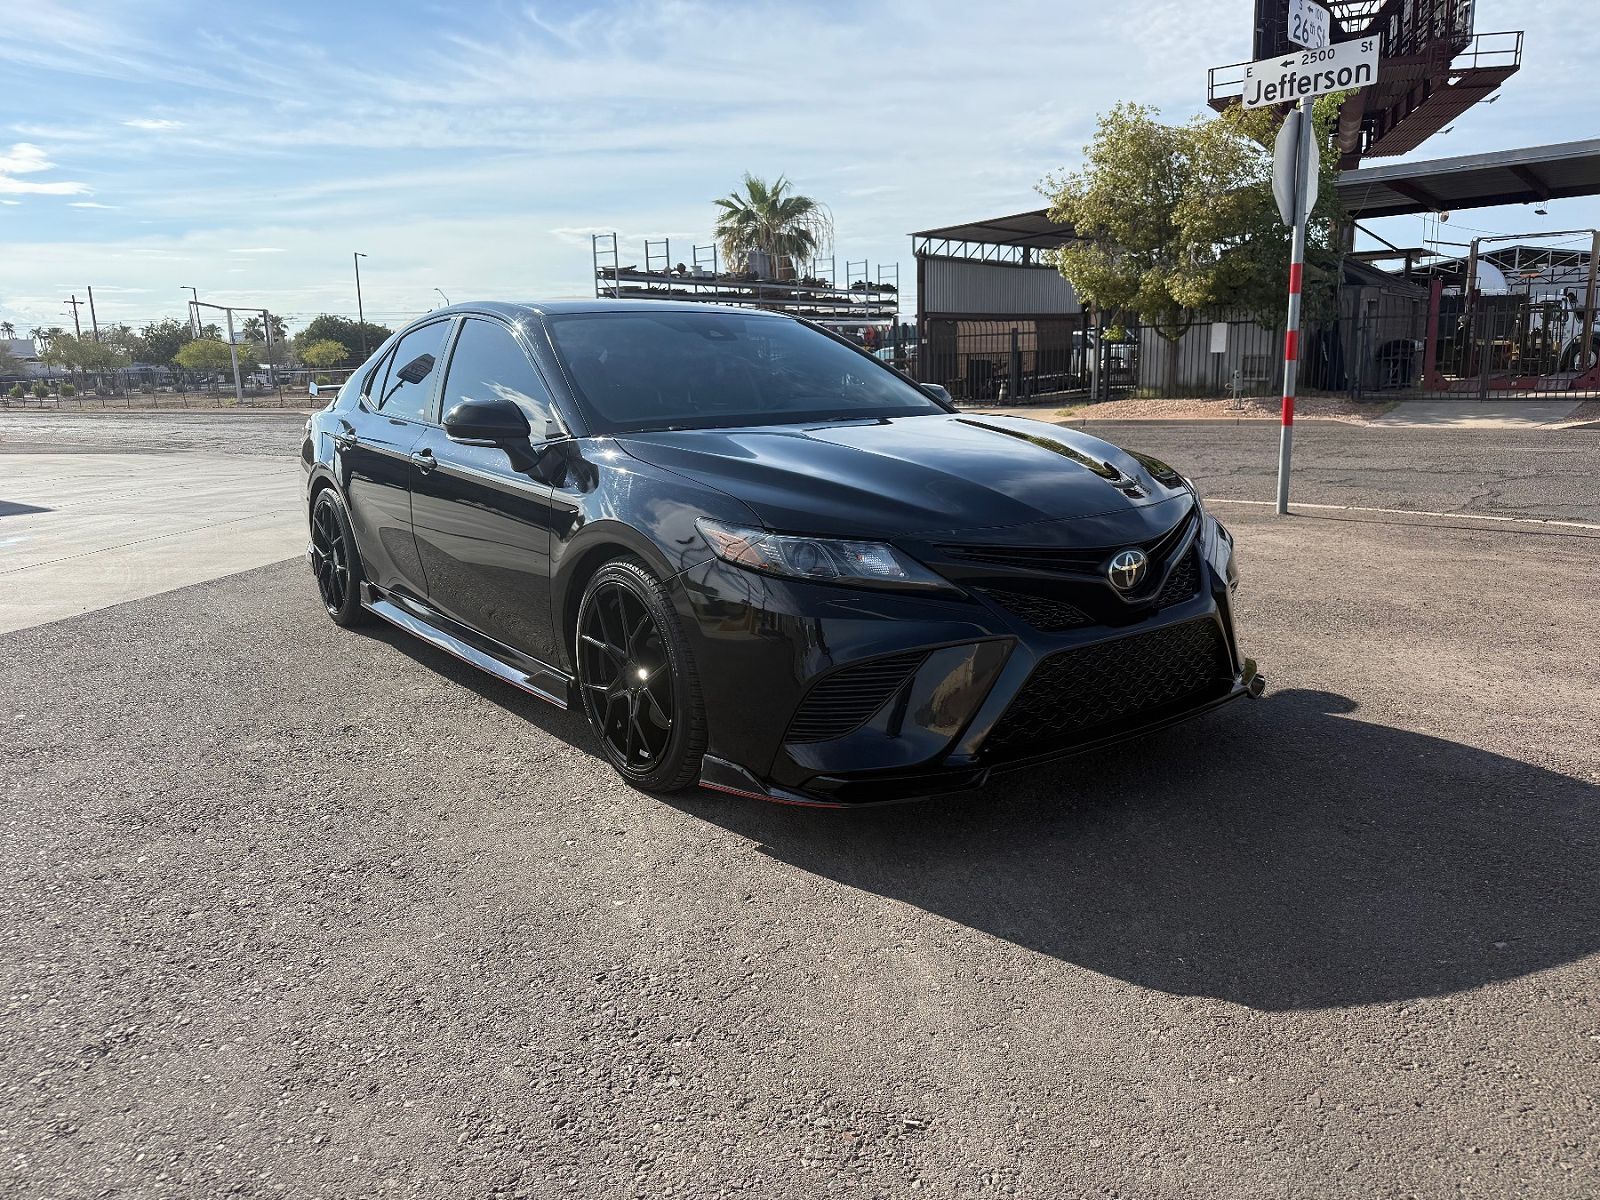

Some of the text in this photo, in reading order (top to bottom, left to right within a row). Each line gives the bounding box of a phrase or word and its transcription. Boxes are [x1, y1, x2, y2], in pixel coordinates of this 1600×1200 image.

[1316, 25, 1326, 48] St
[1246, 41, 1373, 78] E 2500 St
[1247, 63, 1371, 106] Jefferson
